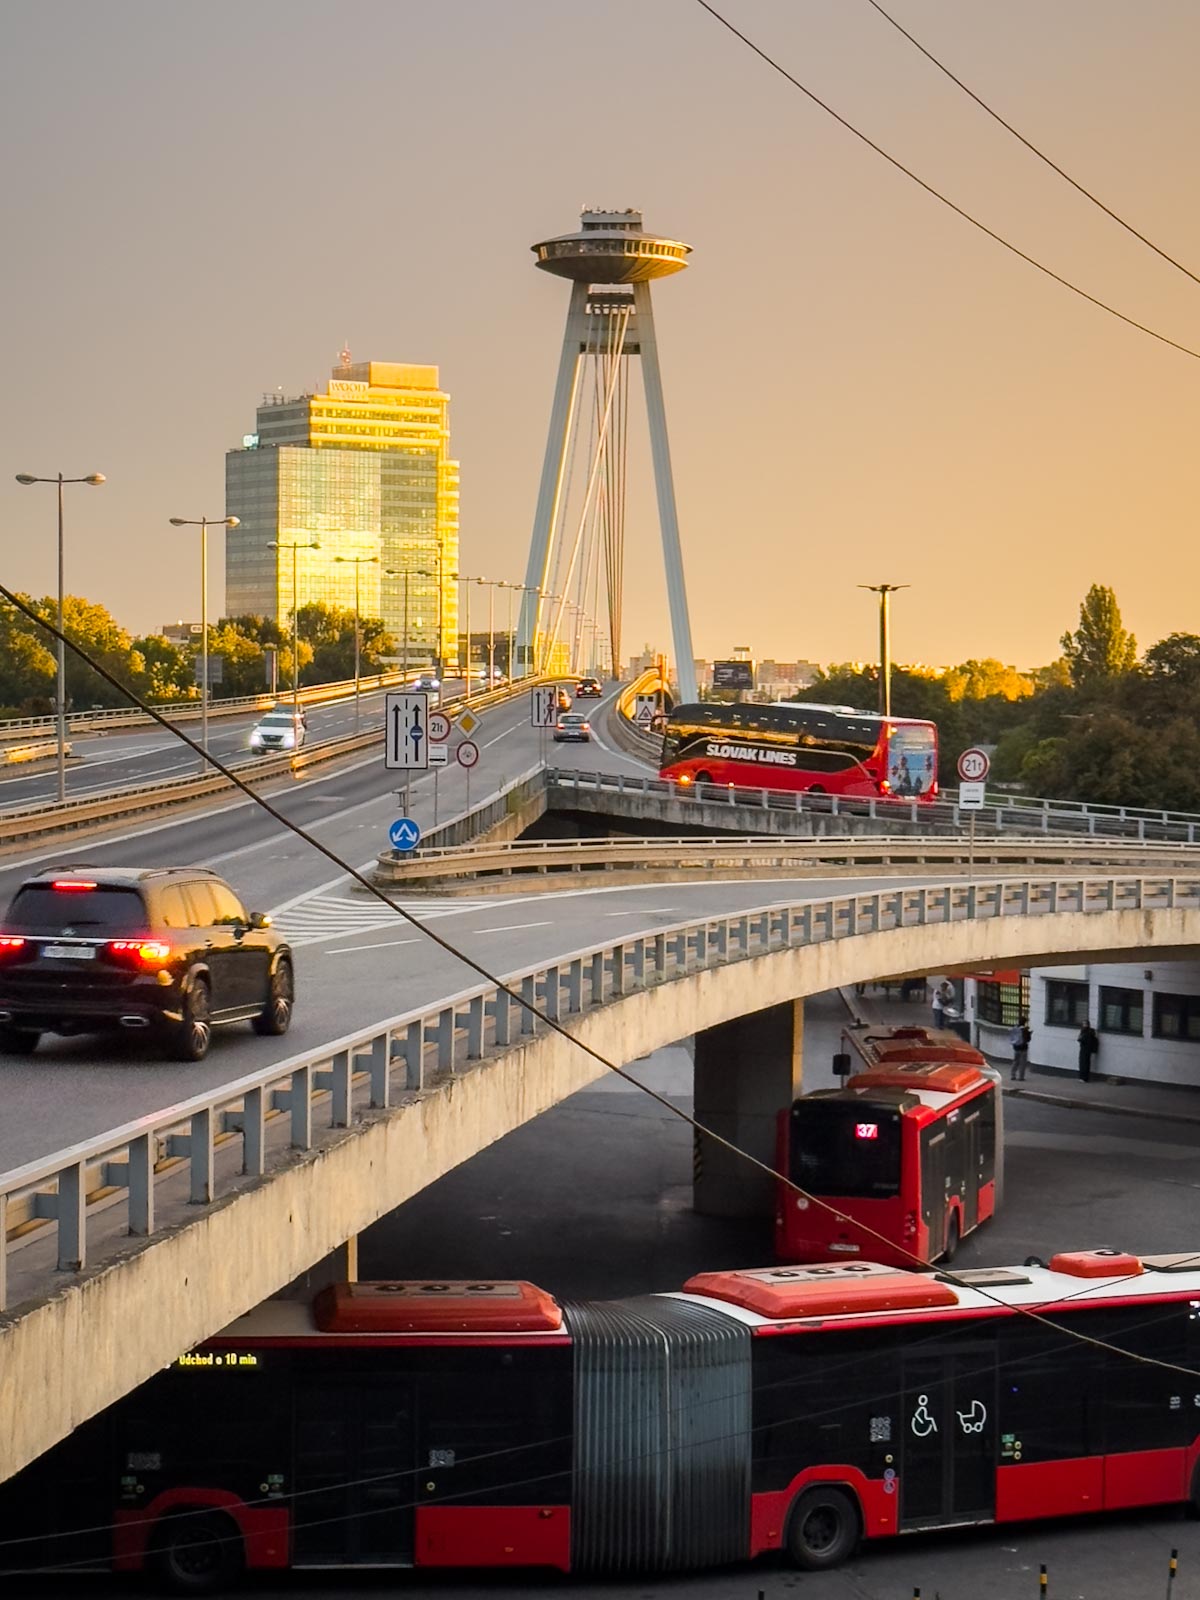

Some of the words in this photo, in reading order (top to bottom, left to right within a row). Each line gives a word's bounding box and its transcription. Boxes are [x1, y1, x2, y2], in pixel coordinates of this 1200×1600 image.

[431, 722, 443, 733] 21t
[706, 743, 758, 761] SLOVAK
[758, 749, 797, 766] LINES
[965, 759, 982, 772] 21t
[858, 1123, 876, 1138] 37
[225, 1352, 237, 1366] 10
[239, 1353, 257, 1366] min
